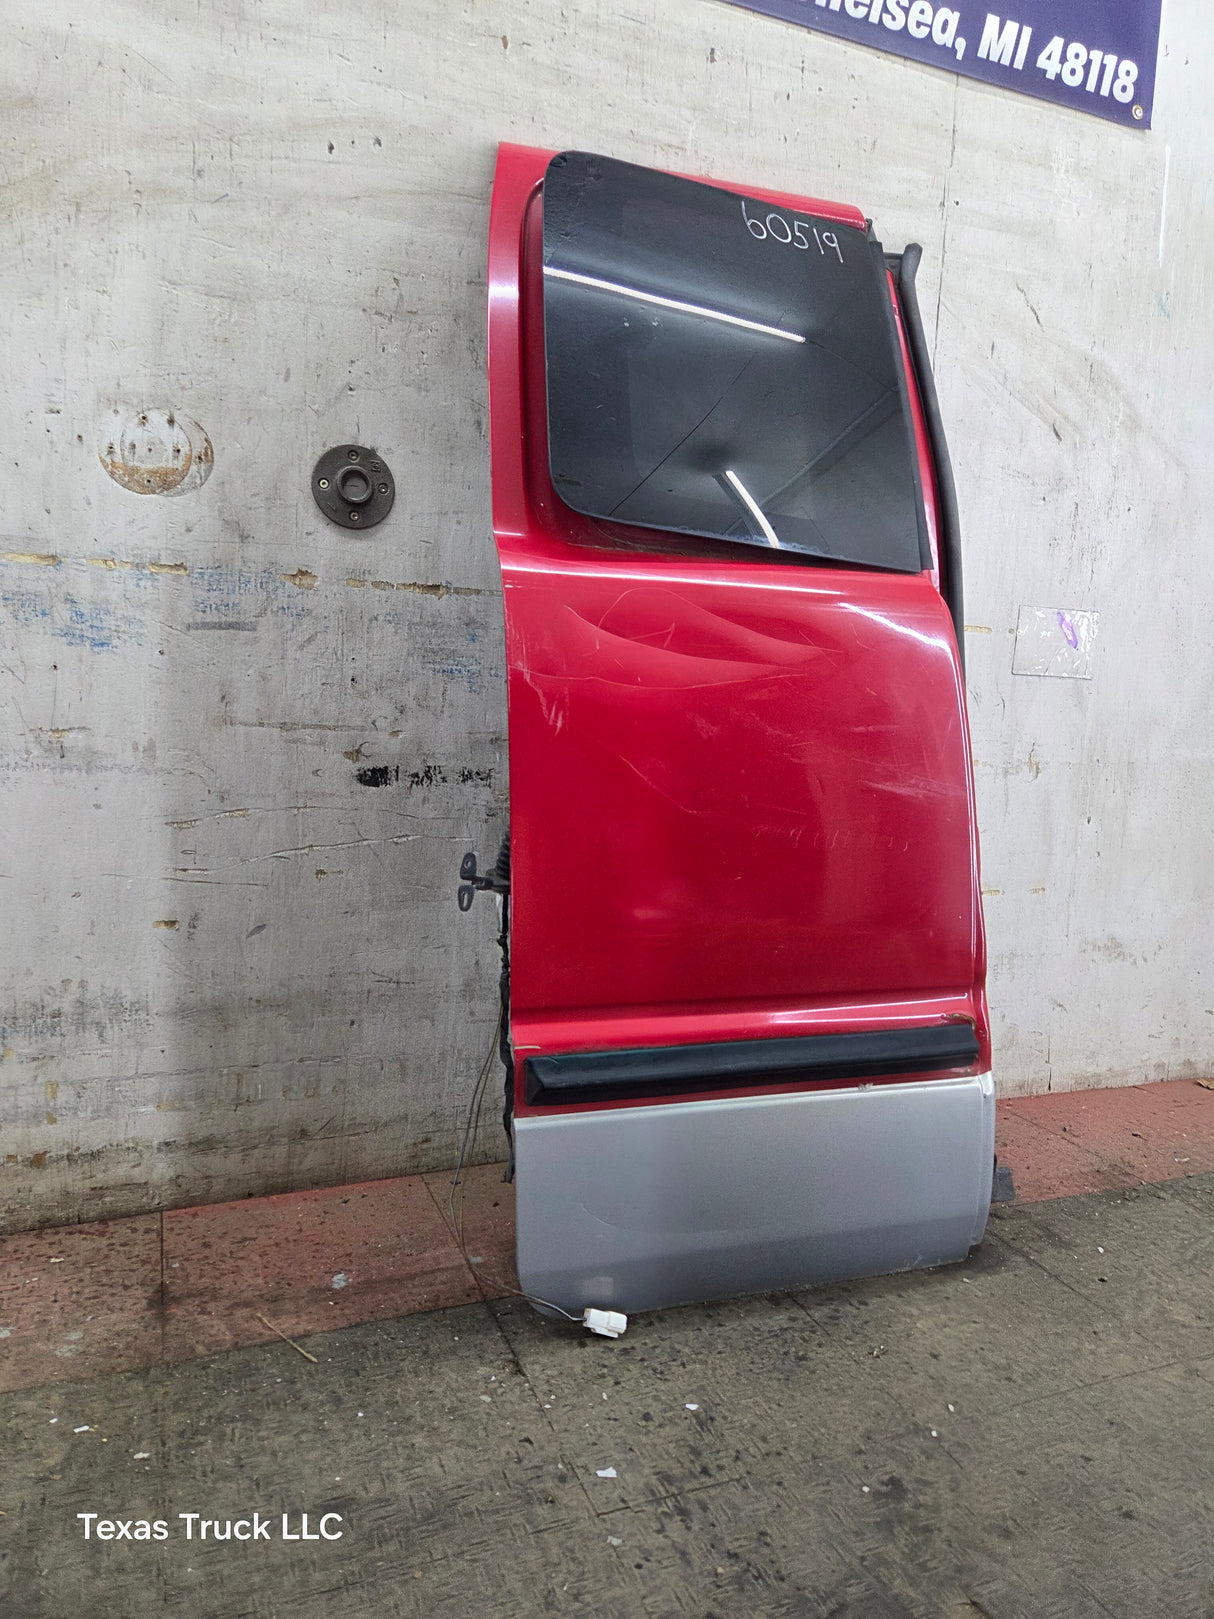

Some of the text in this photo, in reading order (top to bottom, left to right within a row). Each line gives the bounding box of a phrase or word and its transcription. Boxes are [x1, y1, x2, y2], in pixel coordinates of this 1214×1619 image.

[815, 0, 1139, 104] elsea, MI 48118
[741, 200, 844, 264] 60519
